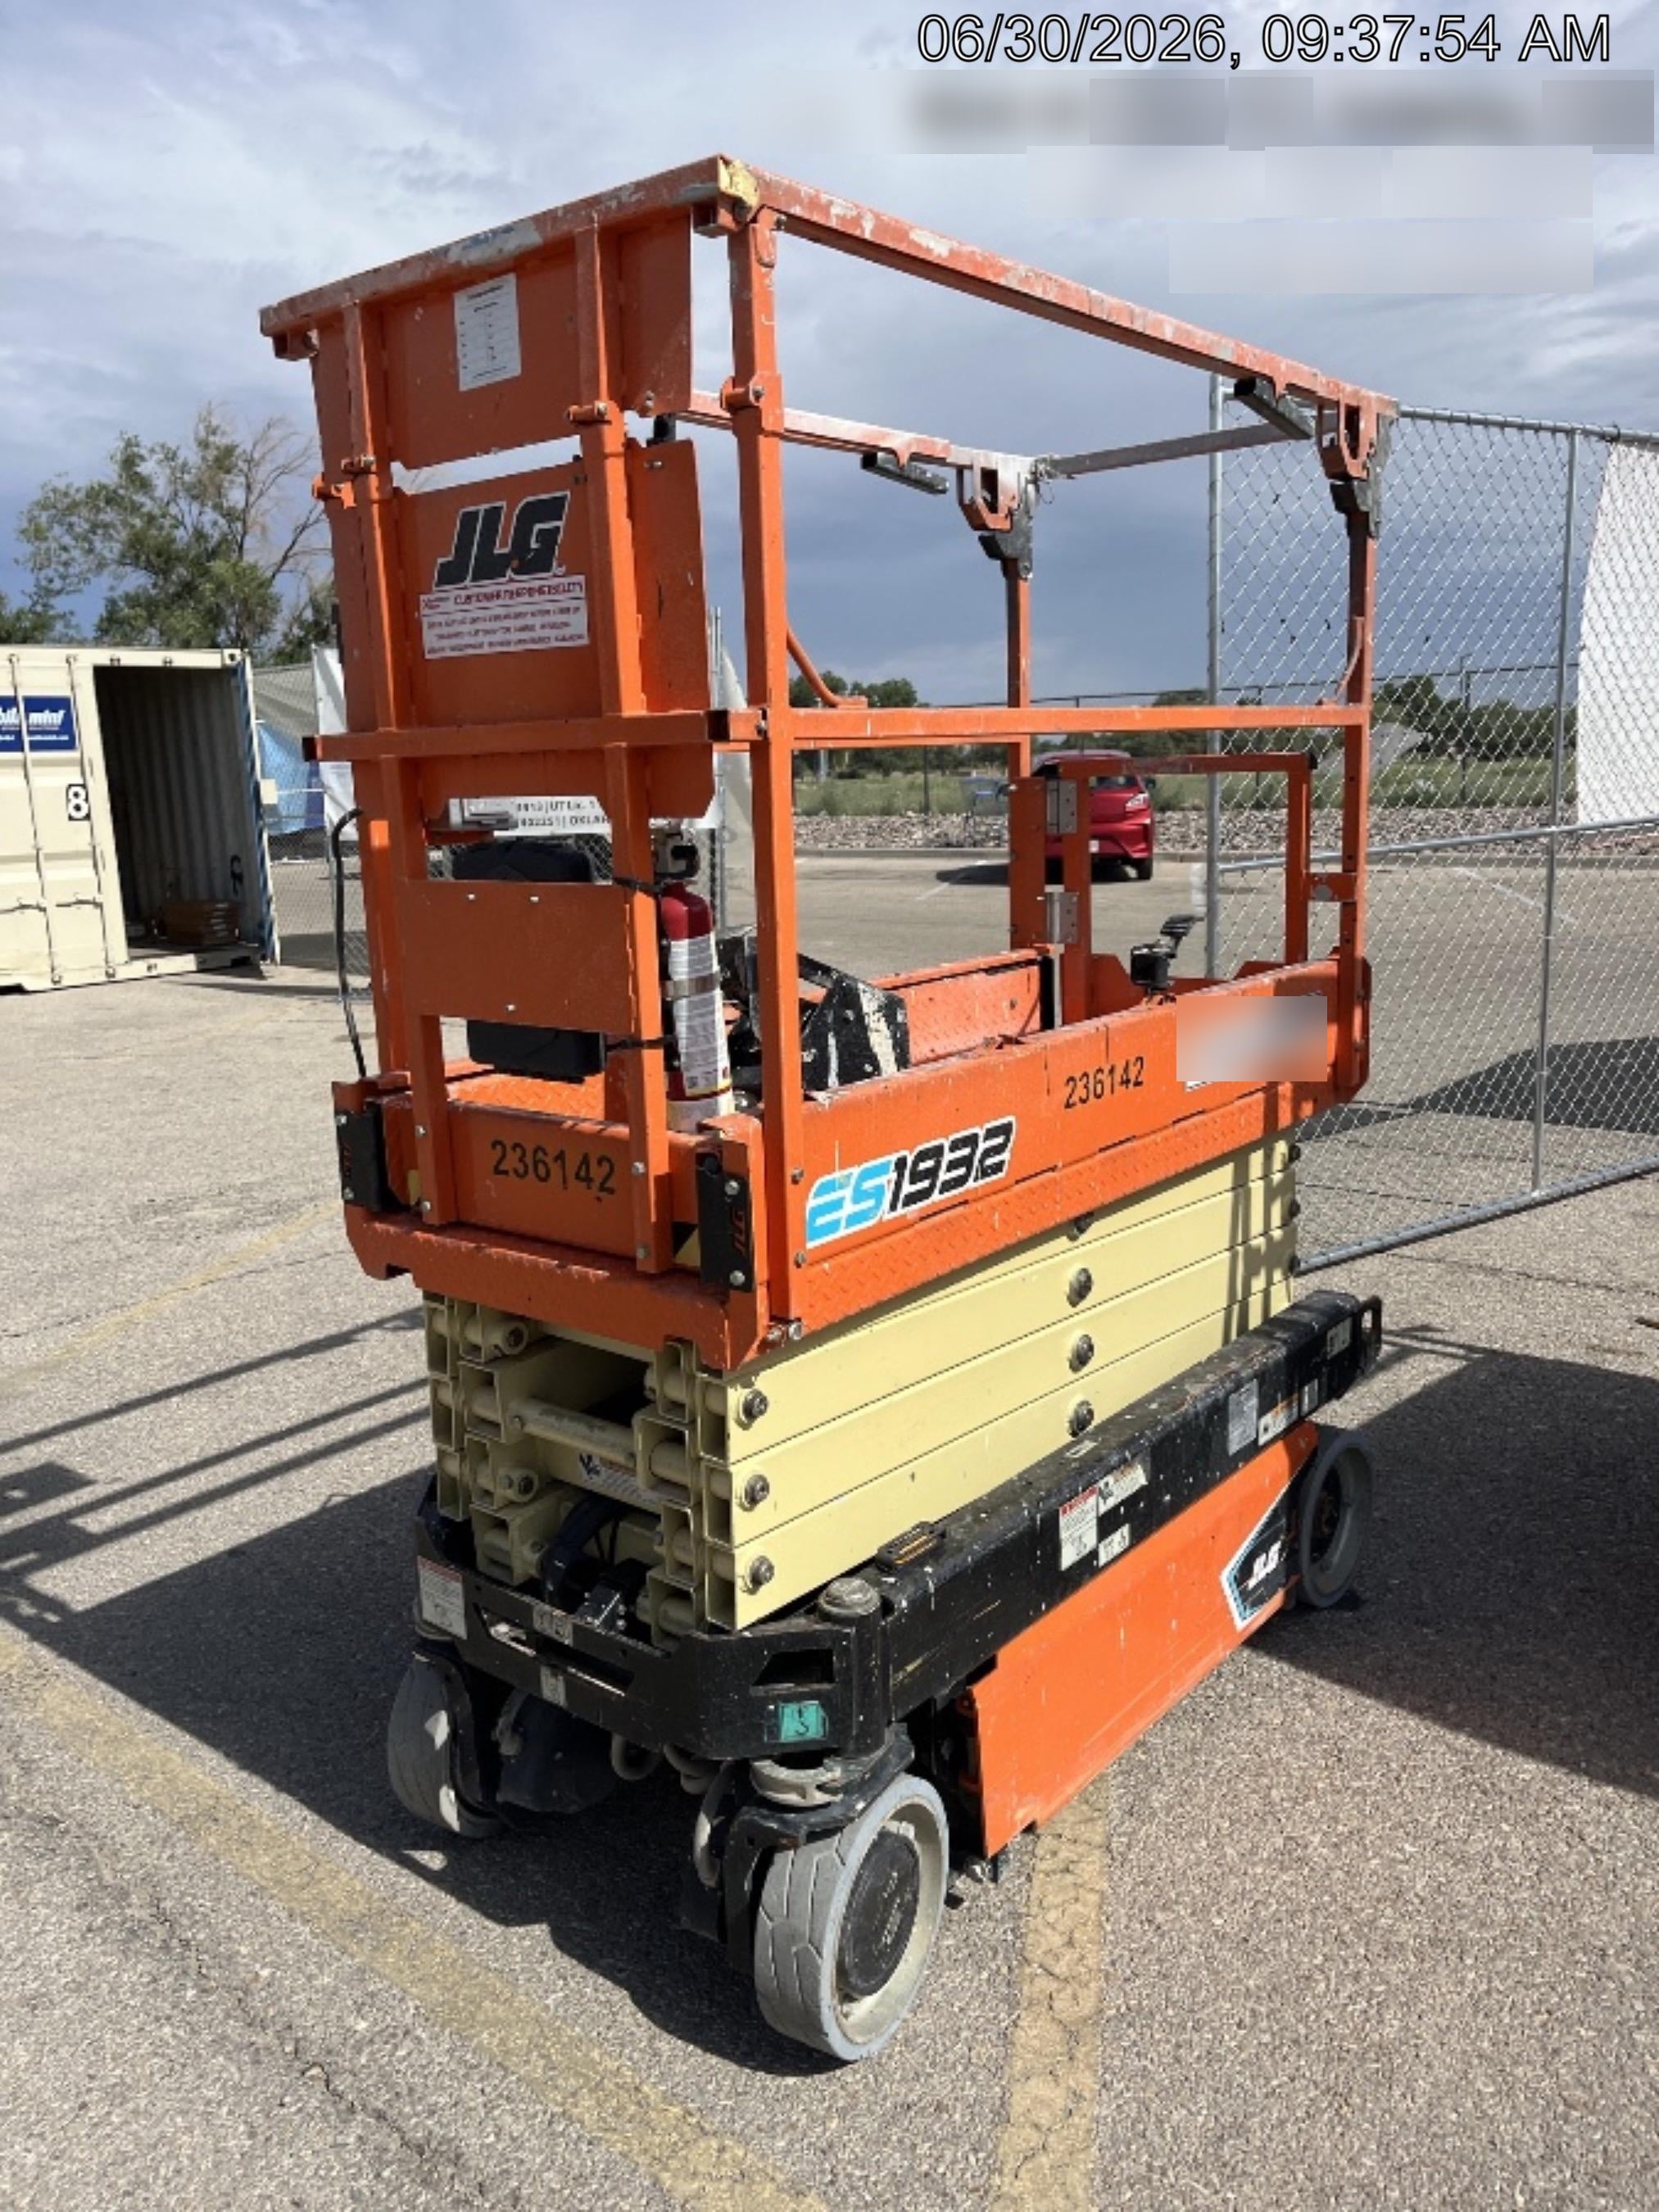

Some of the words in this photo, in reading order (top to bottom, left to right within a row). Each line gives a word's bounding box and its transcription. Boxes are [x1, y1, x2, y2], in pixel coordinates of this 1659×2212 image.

[433, 490, 570, 592] JLG
[67, 786, 89, 820] 8
[1064, 1056, 1145, 1110] 236142
[491, 1140, 617, 1195] 236142
[806, 1116, 1016, 1249] ES1932
